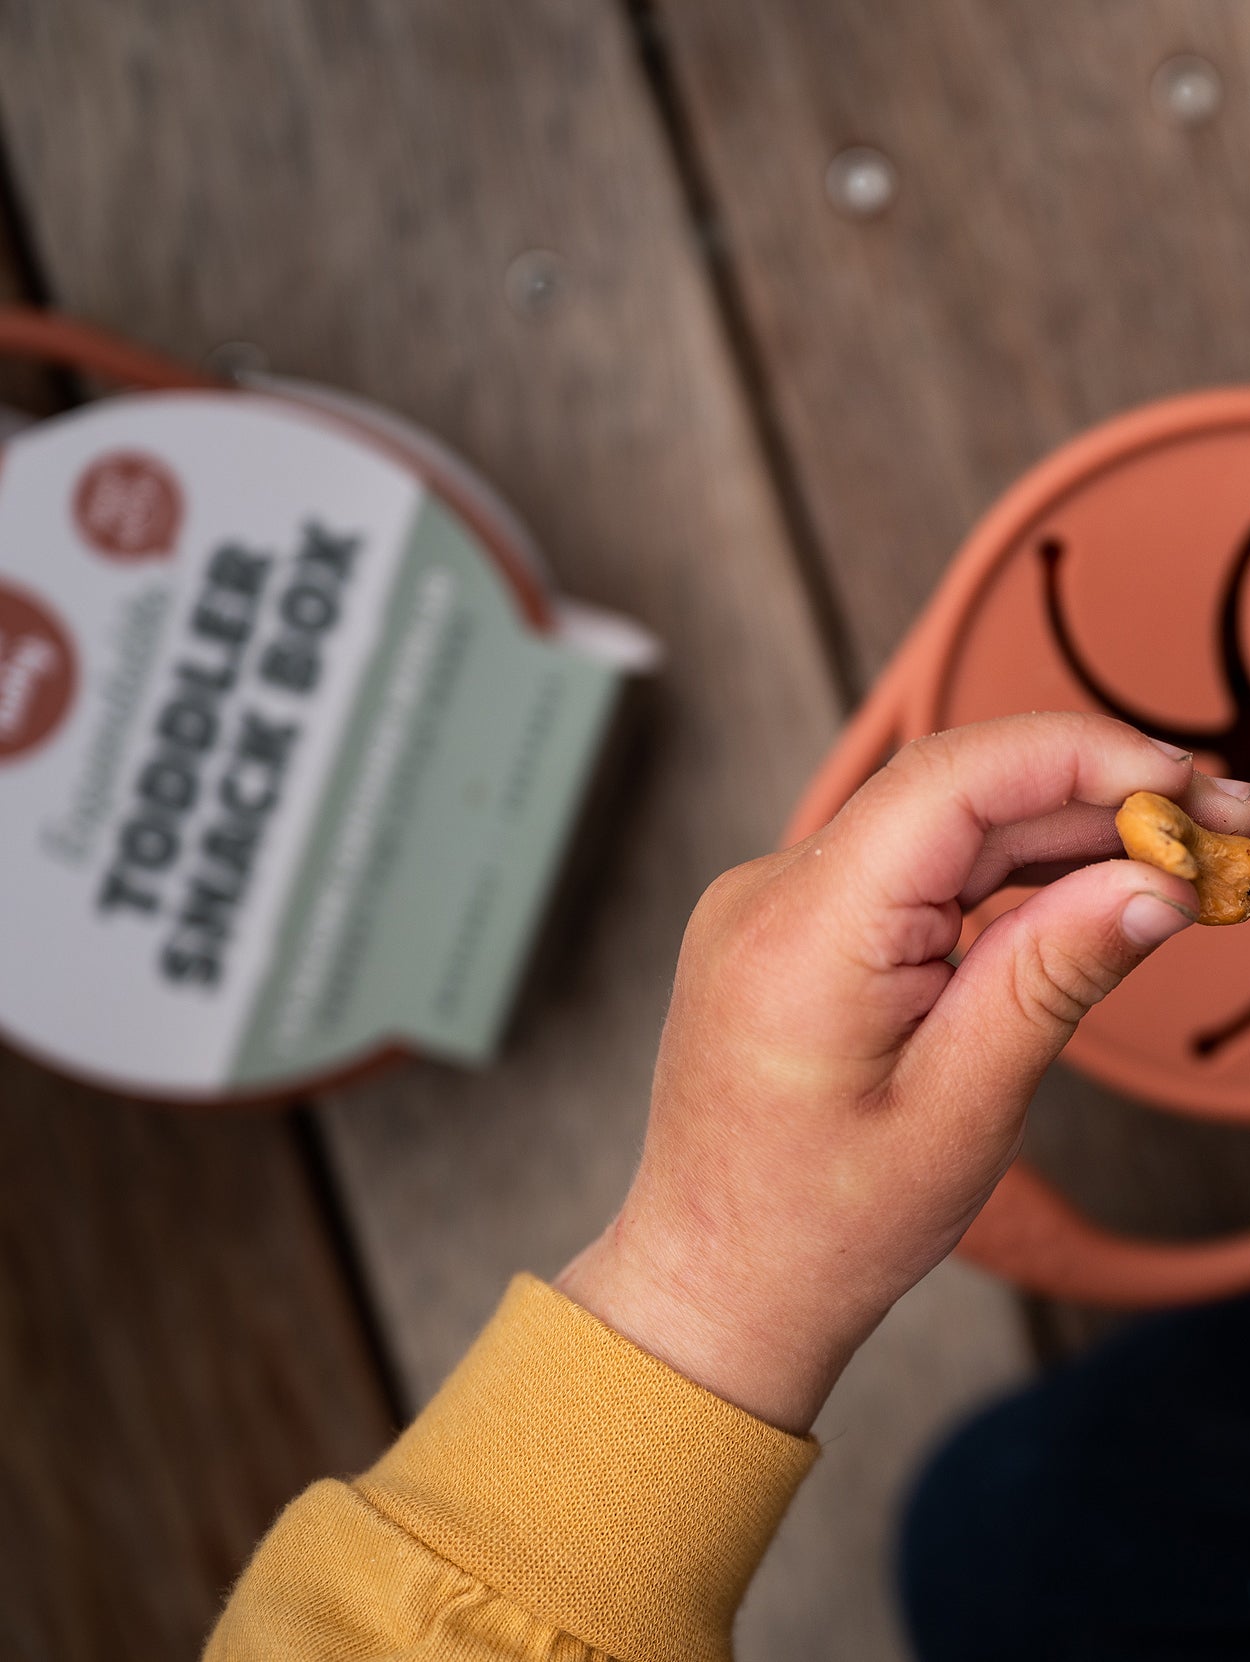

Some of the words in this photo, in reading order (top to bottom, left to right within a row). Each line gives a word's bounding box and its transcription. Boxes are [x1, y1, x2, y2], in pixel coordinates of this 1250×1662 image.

[100, 538, 272, 920] TODDLER
[158, 710, 303, 990] SNACK
[260, 520, 366, 697] BOX
